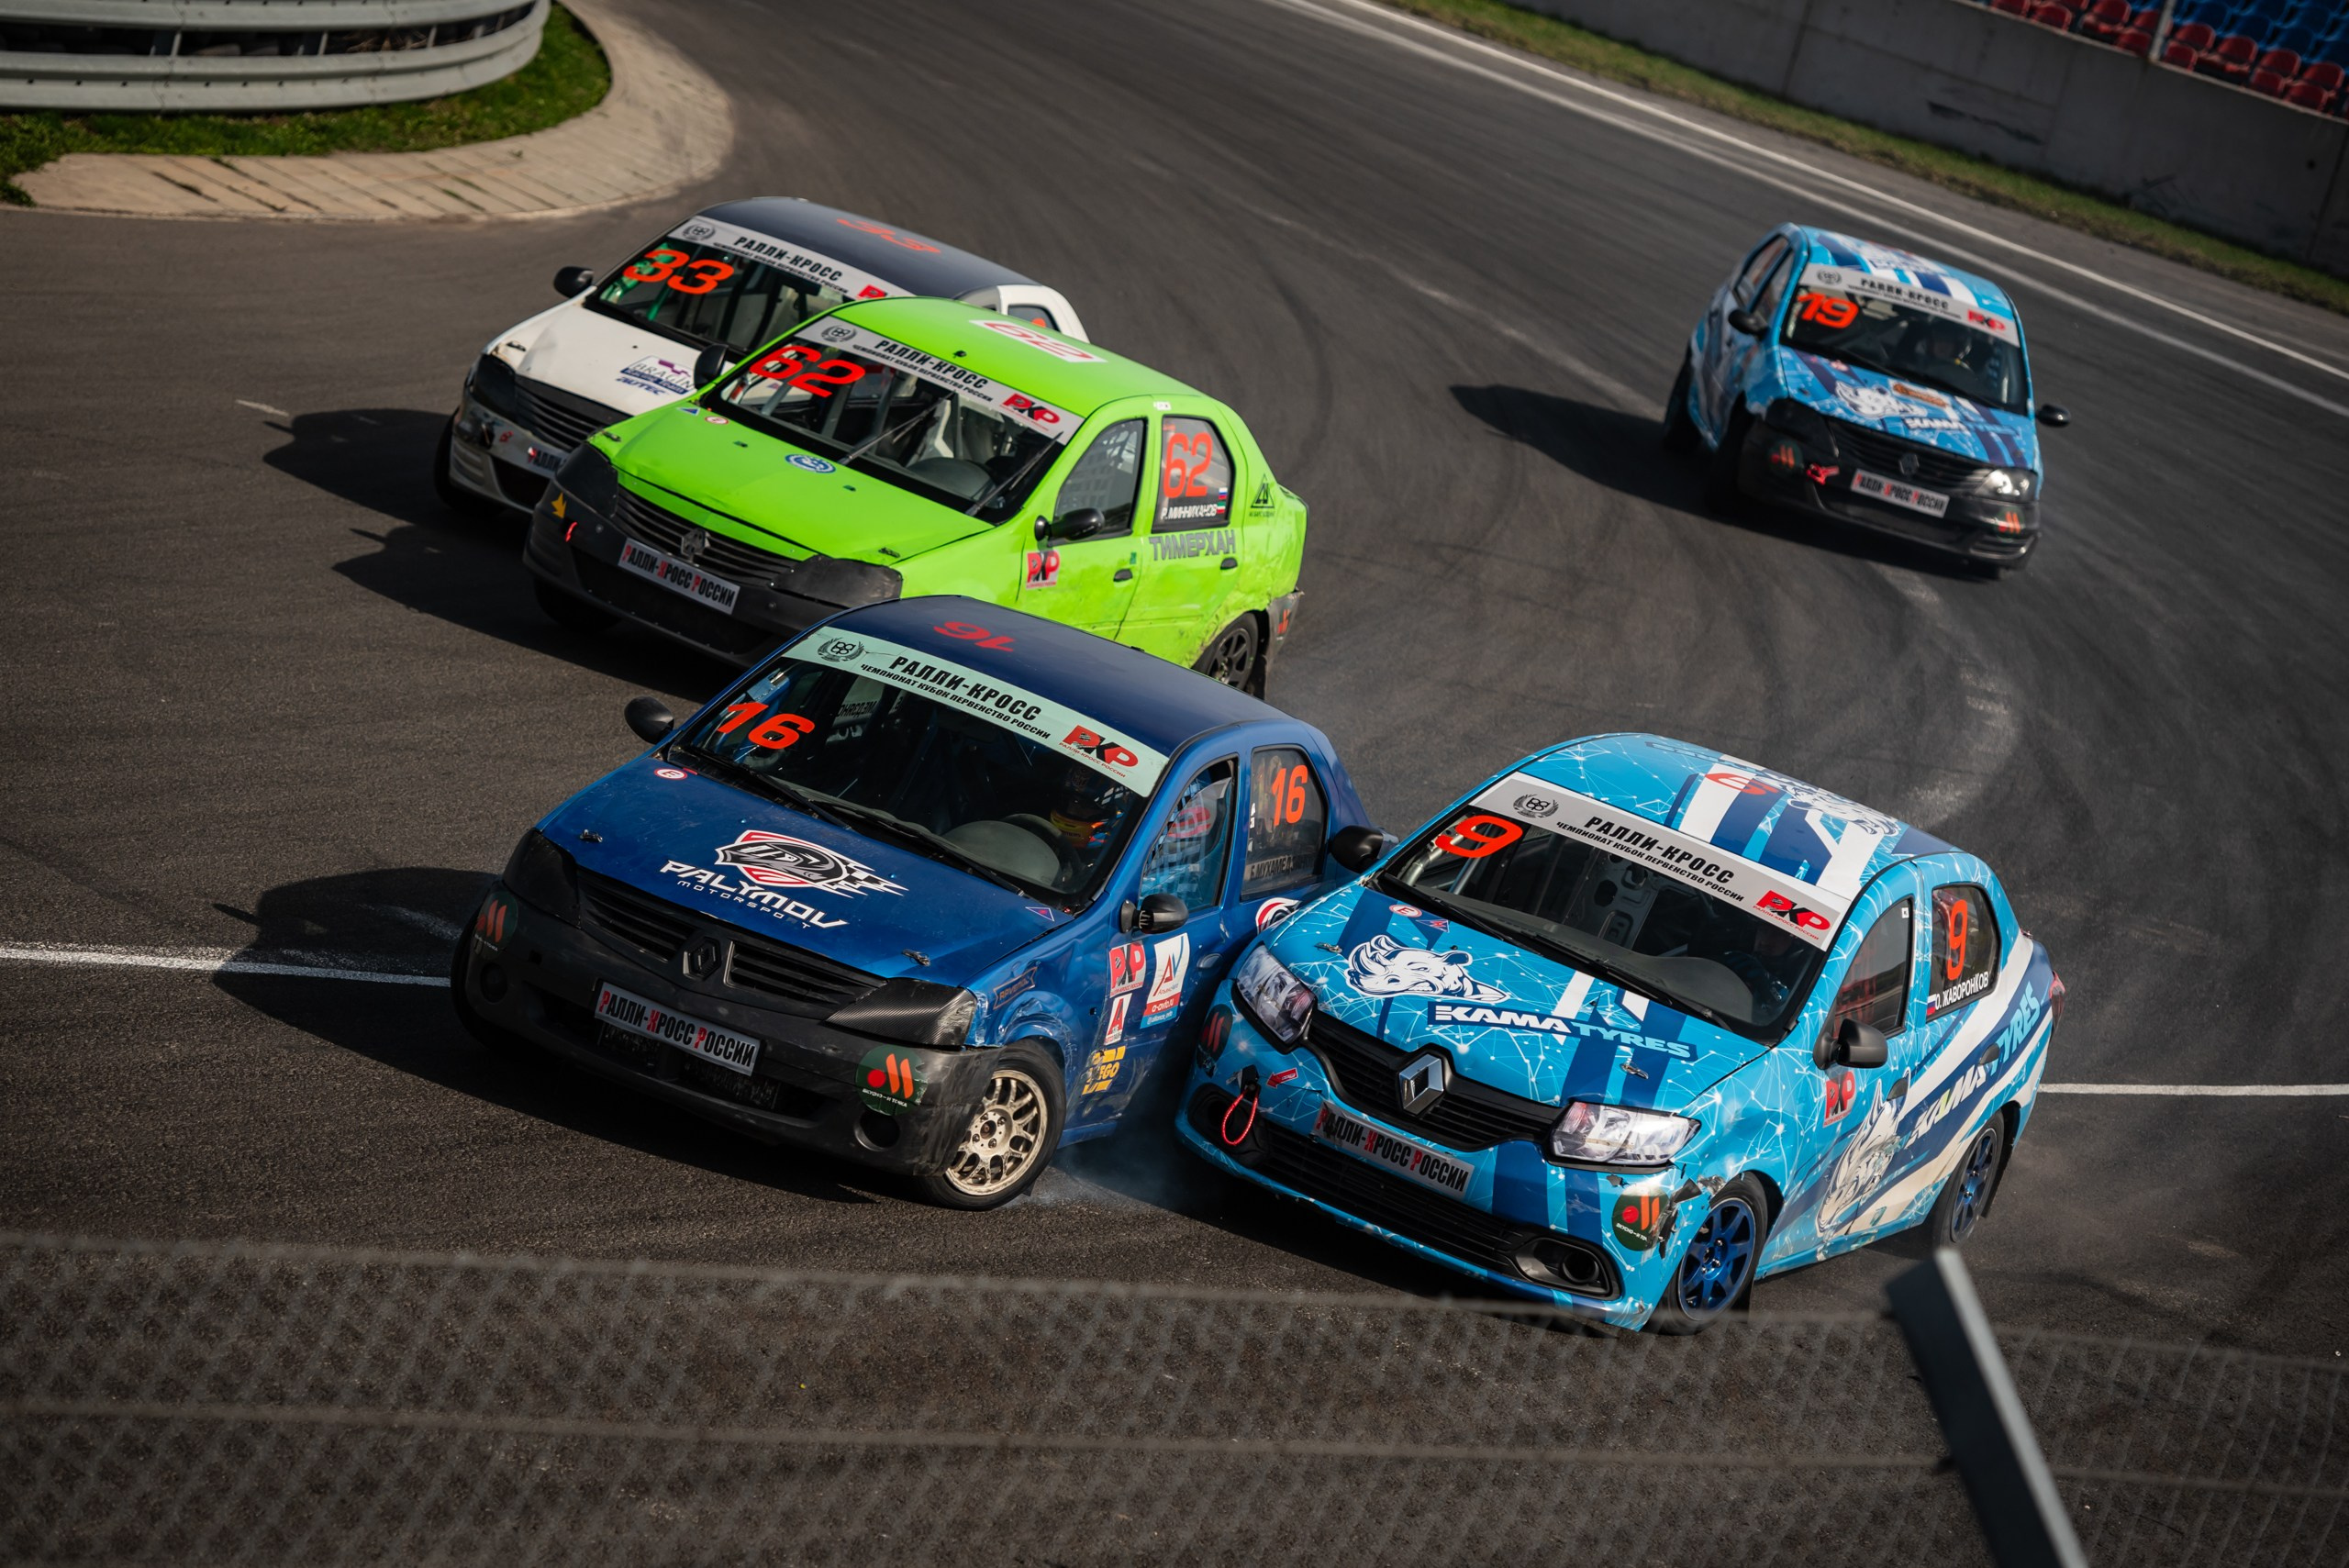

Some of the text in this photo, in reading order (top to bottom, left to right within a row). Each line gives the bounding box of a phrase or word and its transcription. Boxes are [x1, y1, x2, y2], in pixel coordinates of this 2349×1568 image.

[622, 249, 734, 295] 33
[733, 236, 843, 282] РАЛЛИ-КРОСС
[1797, 293, 1860, 328] 19
[749, 345, 866, 398] 62
[874, 339, 989, 389] РАЛЛИ-КРОСС
[1163, 432, 1213, 498] 62
[1148, 529, 1237, 561] ТИМЕРХАН
[620, 544, 737, 608] РАЛЛИ-КРОСС РОССИИ
[860, 663, 1052, 740] ЧЕМПИОНАТ КУБОК ПЕРВЕНСТВО РОССИИ
[888, 655, 1042, 721] РАЛЛИ-КРОСС
[716, 701, 816, 750] 16
[1059, 742, 1126, 778] РАЛЛИ-КРОСС РОССИИ
[1271, 764, 1309, 827] 16
[1436, 816, 1523, 858] 9
[1556, 821, 1745, 903] ЧЕМПИОНАТ КУБОК ПЕРВЕНСТВО РОССИИ
[1585, 816, 1735, 884] РАЛЛИ-КРОСС
[660, 860, 850, 929] PALYMOV
[676, 880, 812, 929] MOTORSPOT
[1753, 906, 1820, 940] РАЛЛИ-КРОСС РОССИИ
[1947, 899, 1968, 981] 9
[1943, 972, 1989, 1007] ЖАВОРОНКОВ
[598, 990, 756, 1068] РАЛЛИ-КРОСС РОССИИ
[1435, 1004, 1691, 1058] KAMA TYRES
[1316, 1108, 1469, 1193] РАЛЛИ-КРОСС РОССИИ
